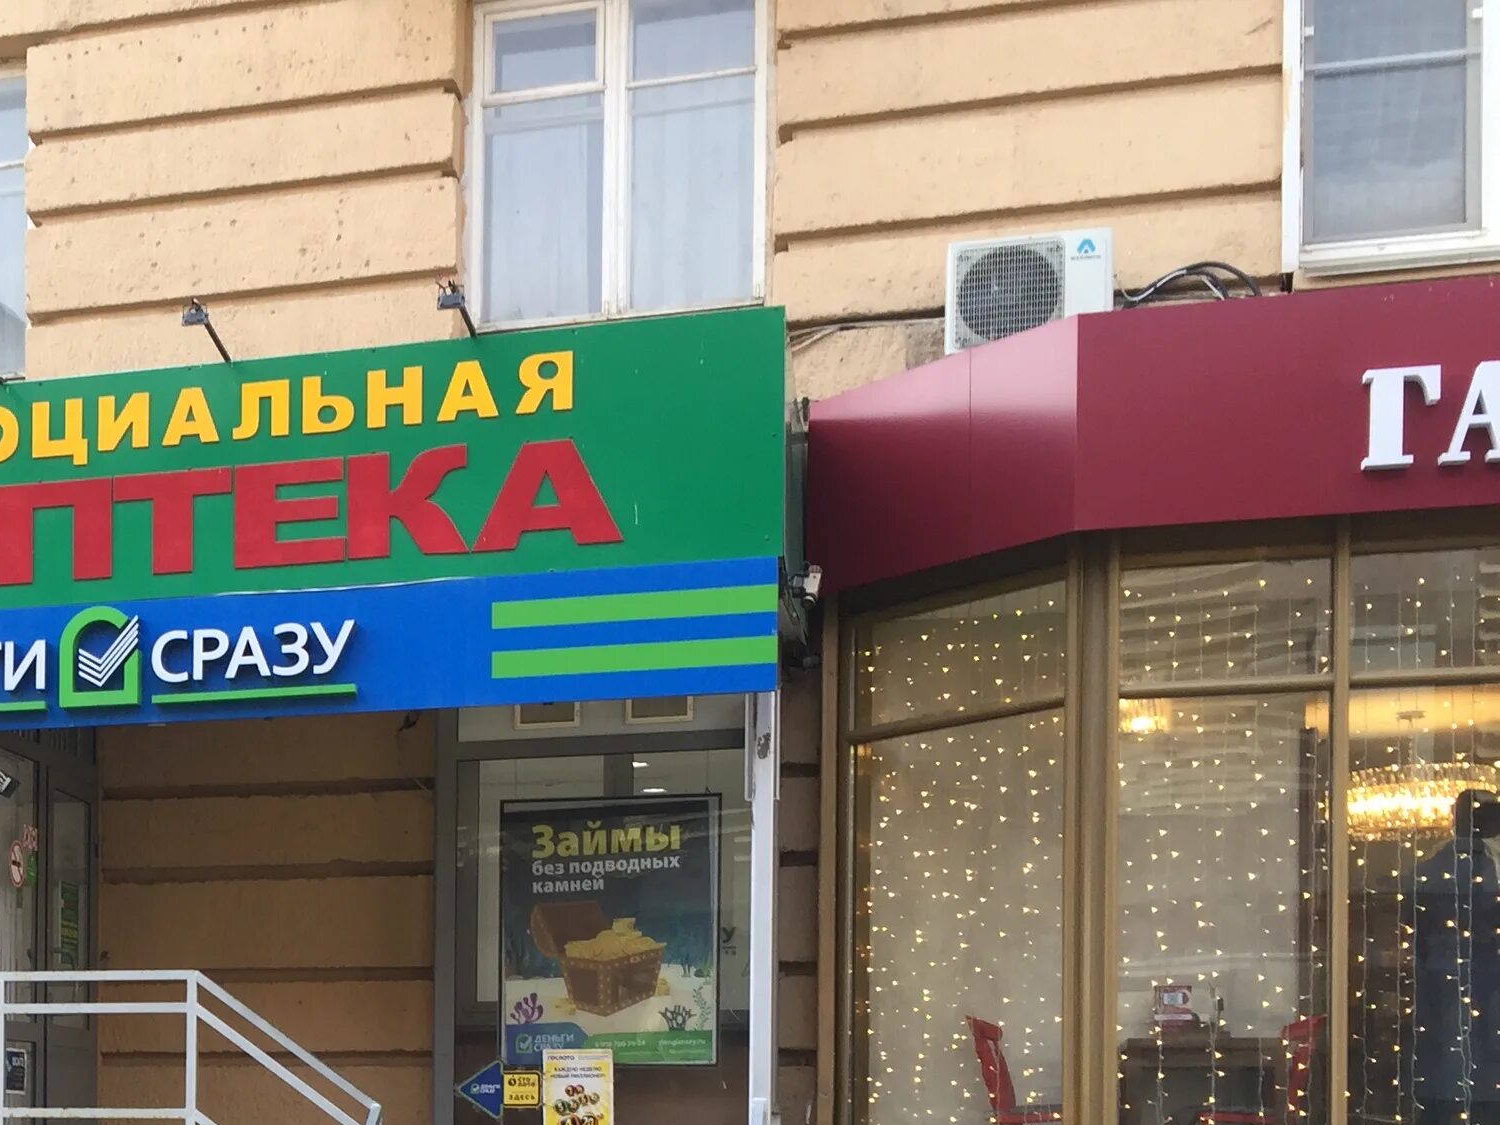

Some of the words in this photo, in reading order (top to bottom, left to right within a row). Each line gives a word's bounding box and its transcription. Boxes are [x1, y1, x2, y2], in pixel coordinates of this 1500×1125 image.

[151, 619, 356, 683] СРАЗУ
[532, 820, 682, 859] Займы
[532, 860, 565, 876] без
[569, 855, 681, 875] подводных
[532, 873, 605, 894] камней
[534, 1033, 574, 1043] ДЕНЬГИ
